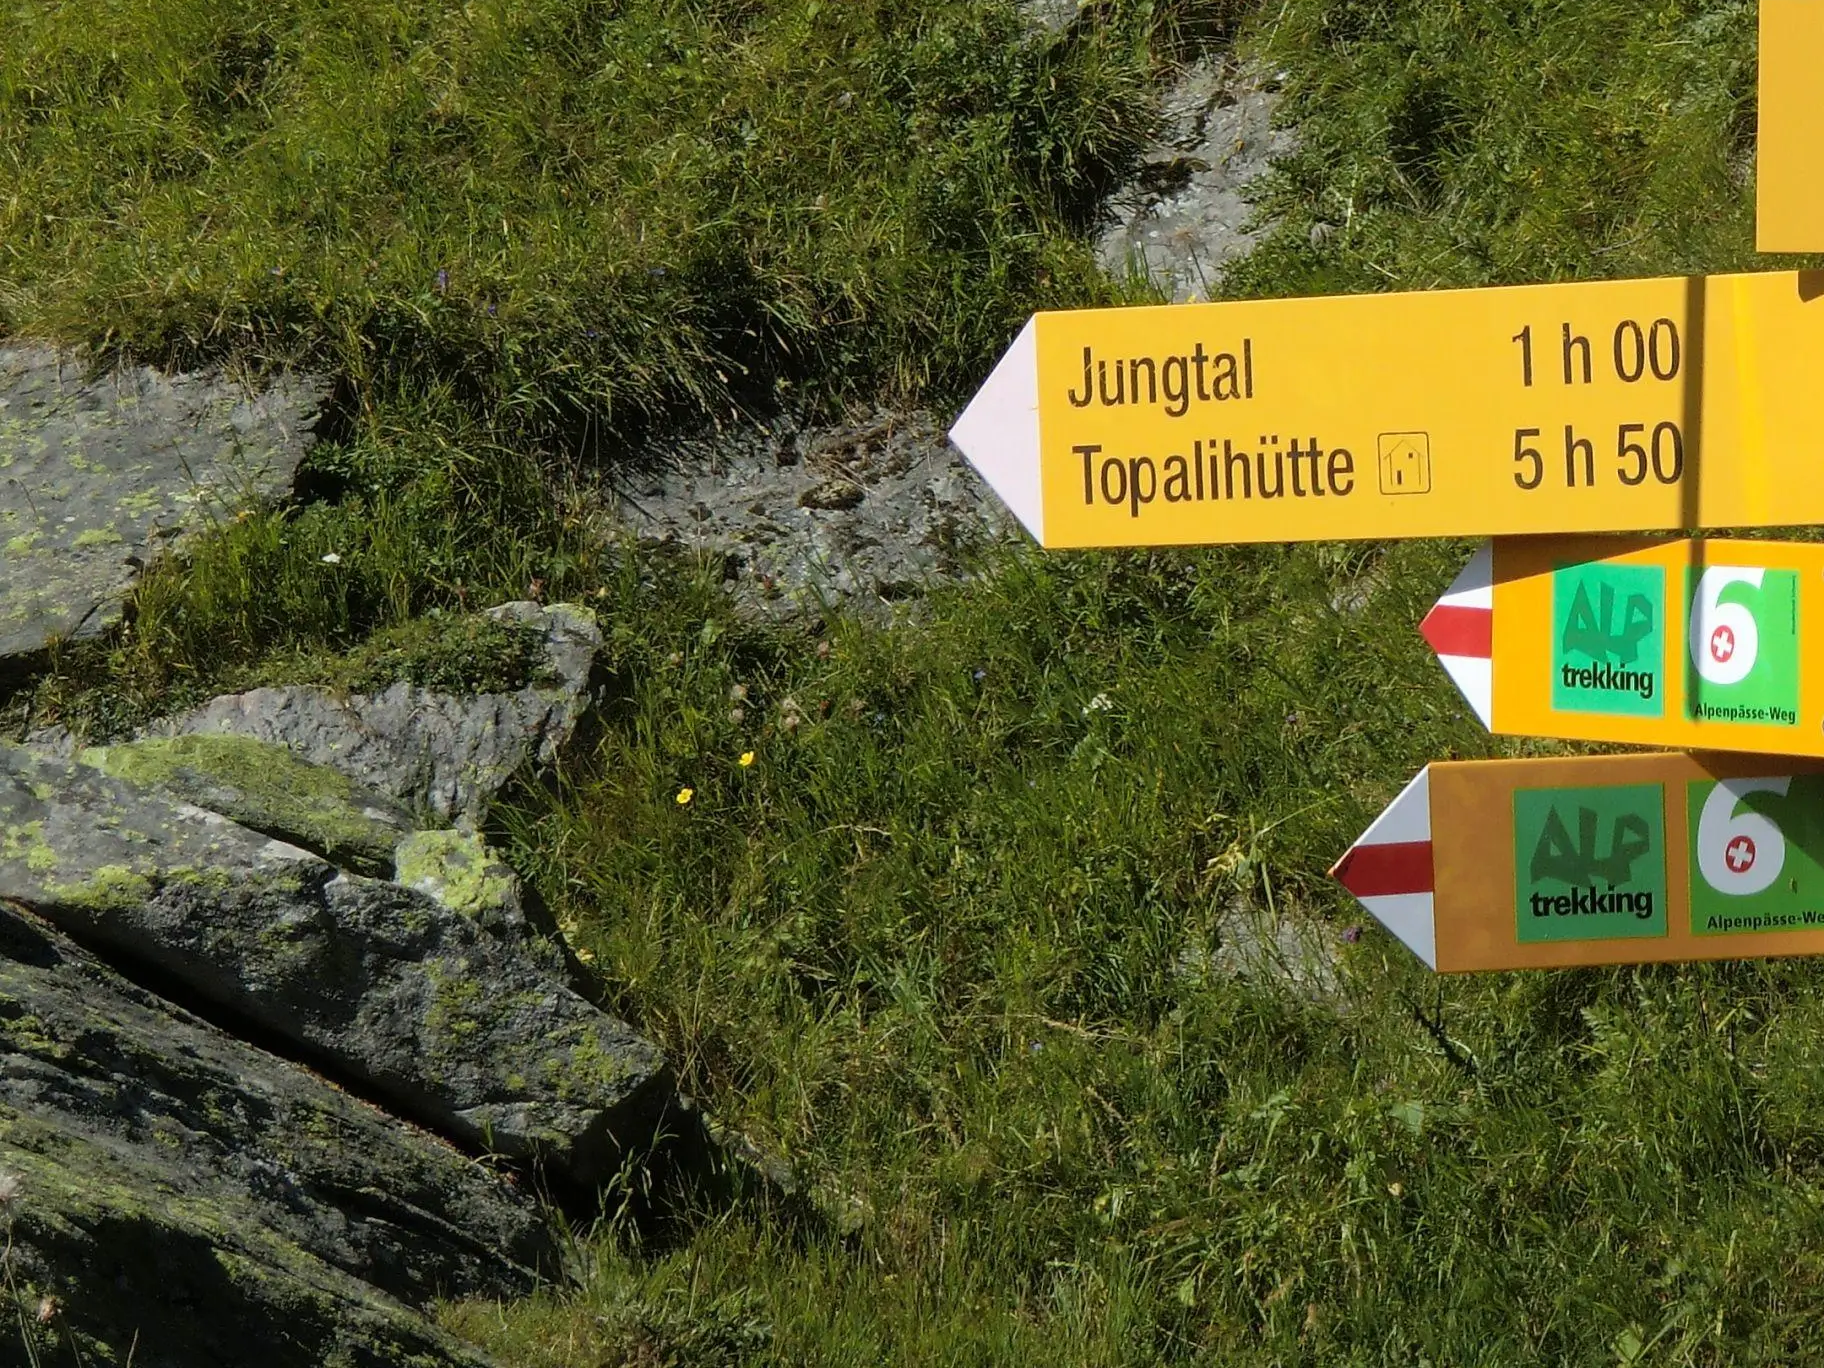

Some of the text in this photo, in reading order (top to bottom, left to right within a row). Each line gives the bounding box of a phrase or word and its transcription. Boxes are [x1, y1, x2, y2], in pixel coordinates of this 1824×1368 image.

[1068, 317, 1680, 418] Jungtal 1 h 00
[1072, 420, 1683, 517] Topalihütte 5 h 50
[1689, 565, 1765, 685] 6
[1562, 660, 1654, 699] trekking
[1694, 702, 1796, 725] Alpenpässe-Weg
[1698, 775, 1792, 896] 6
[1529, 884, 1653, 920] trekking
